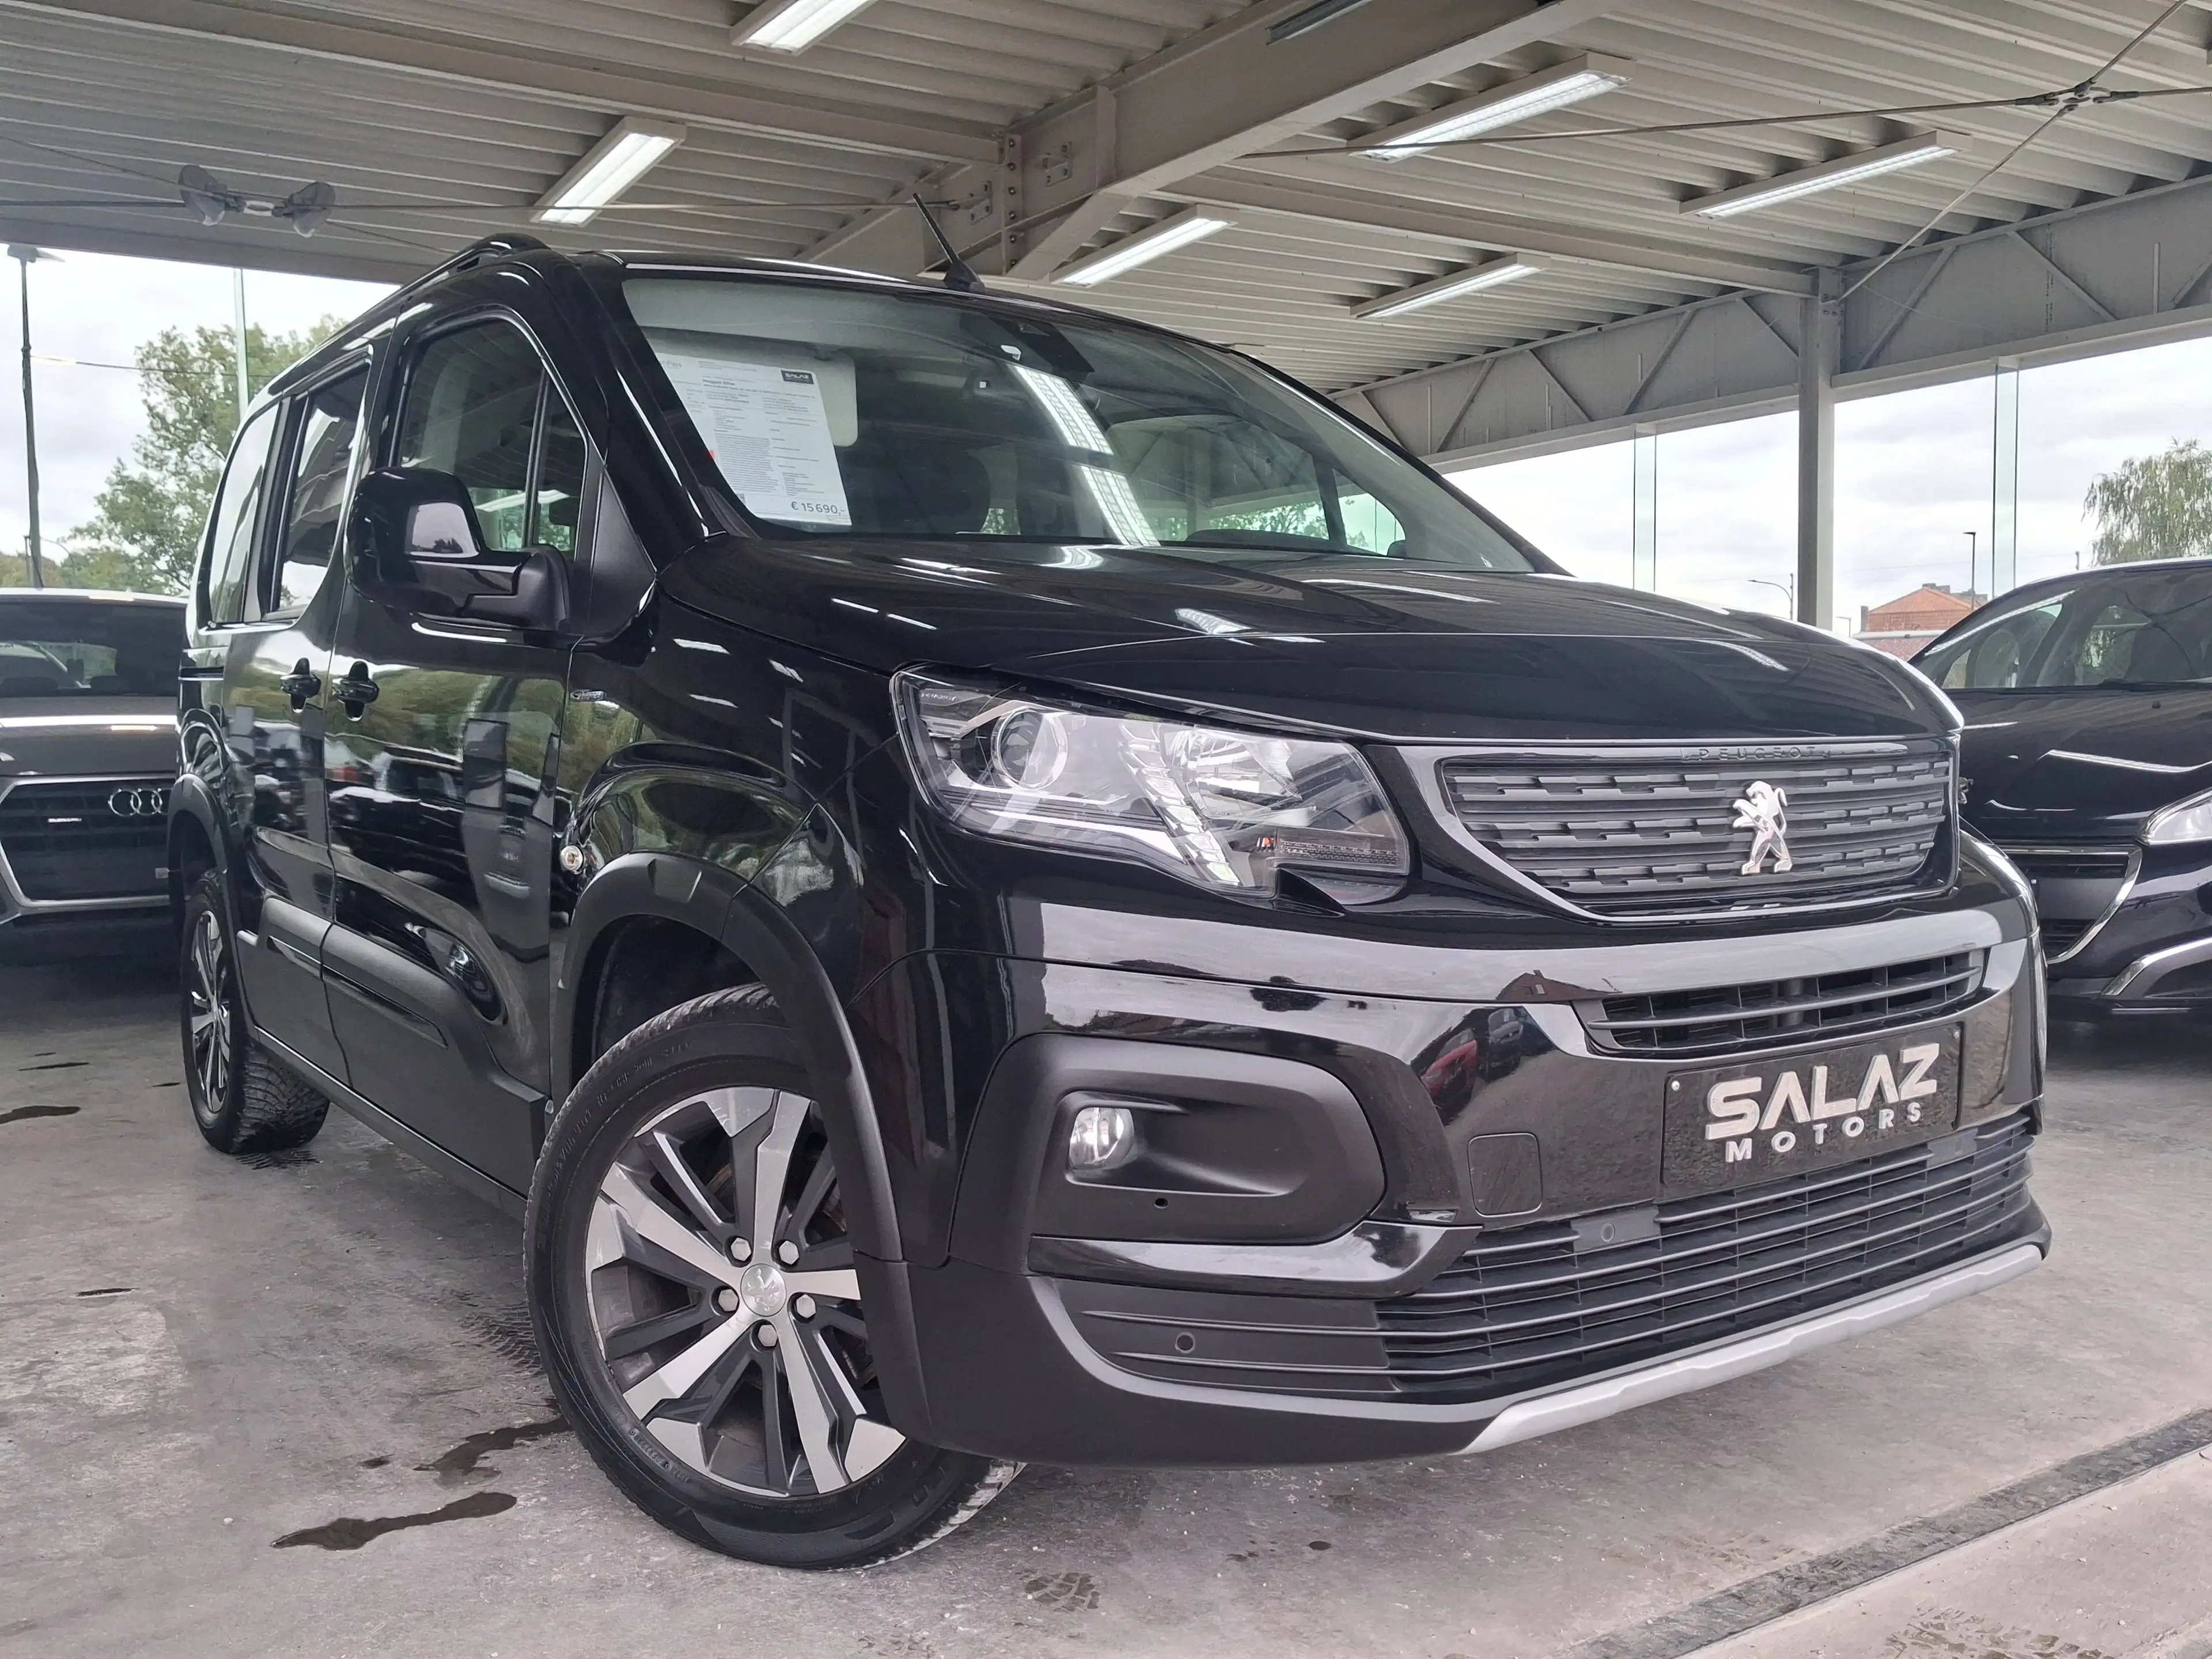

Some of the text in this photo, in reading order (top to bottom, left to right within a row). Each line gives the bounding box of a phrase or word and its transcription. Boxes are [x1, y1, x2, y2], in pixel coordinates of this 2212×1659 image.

[1698, 746, 1815, 761] PEUGEOT
[1705, 1043, 1940, 1141] SALAZ
[1725, 1102, 1921, 1163] MOTORS
